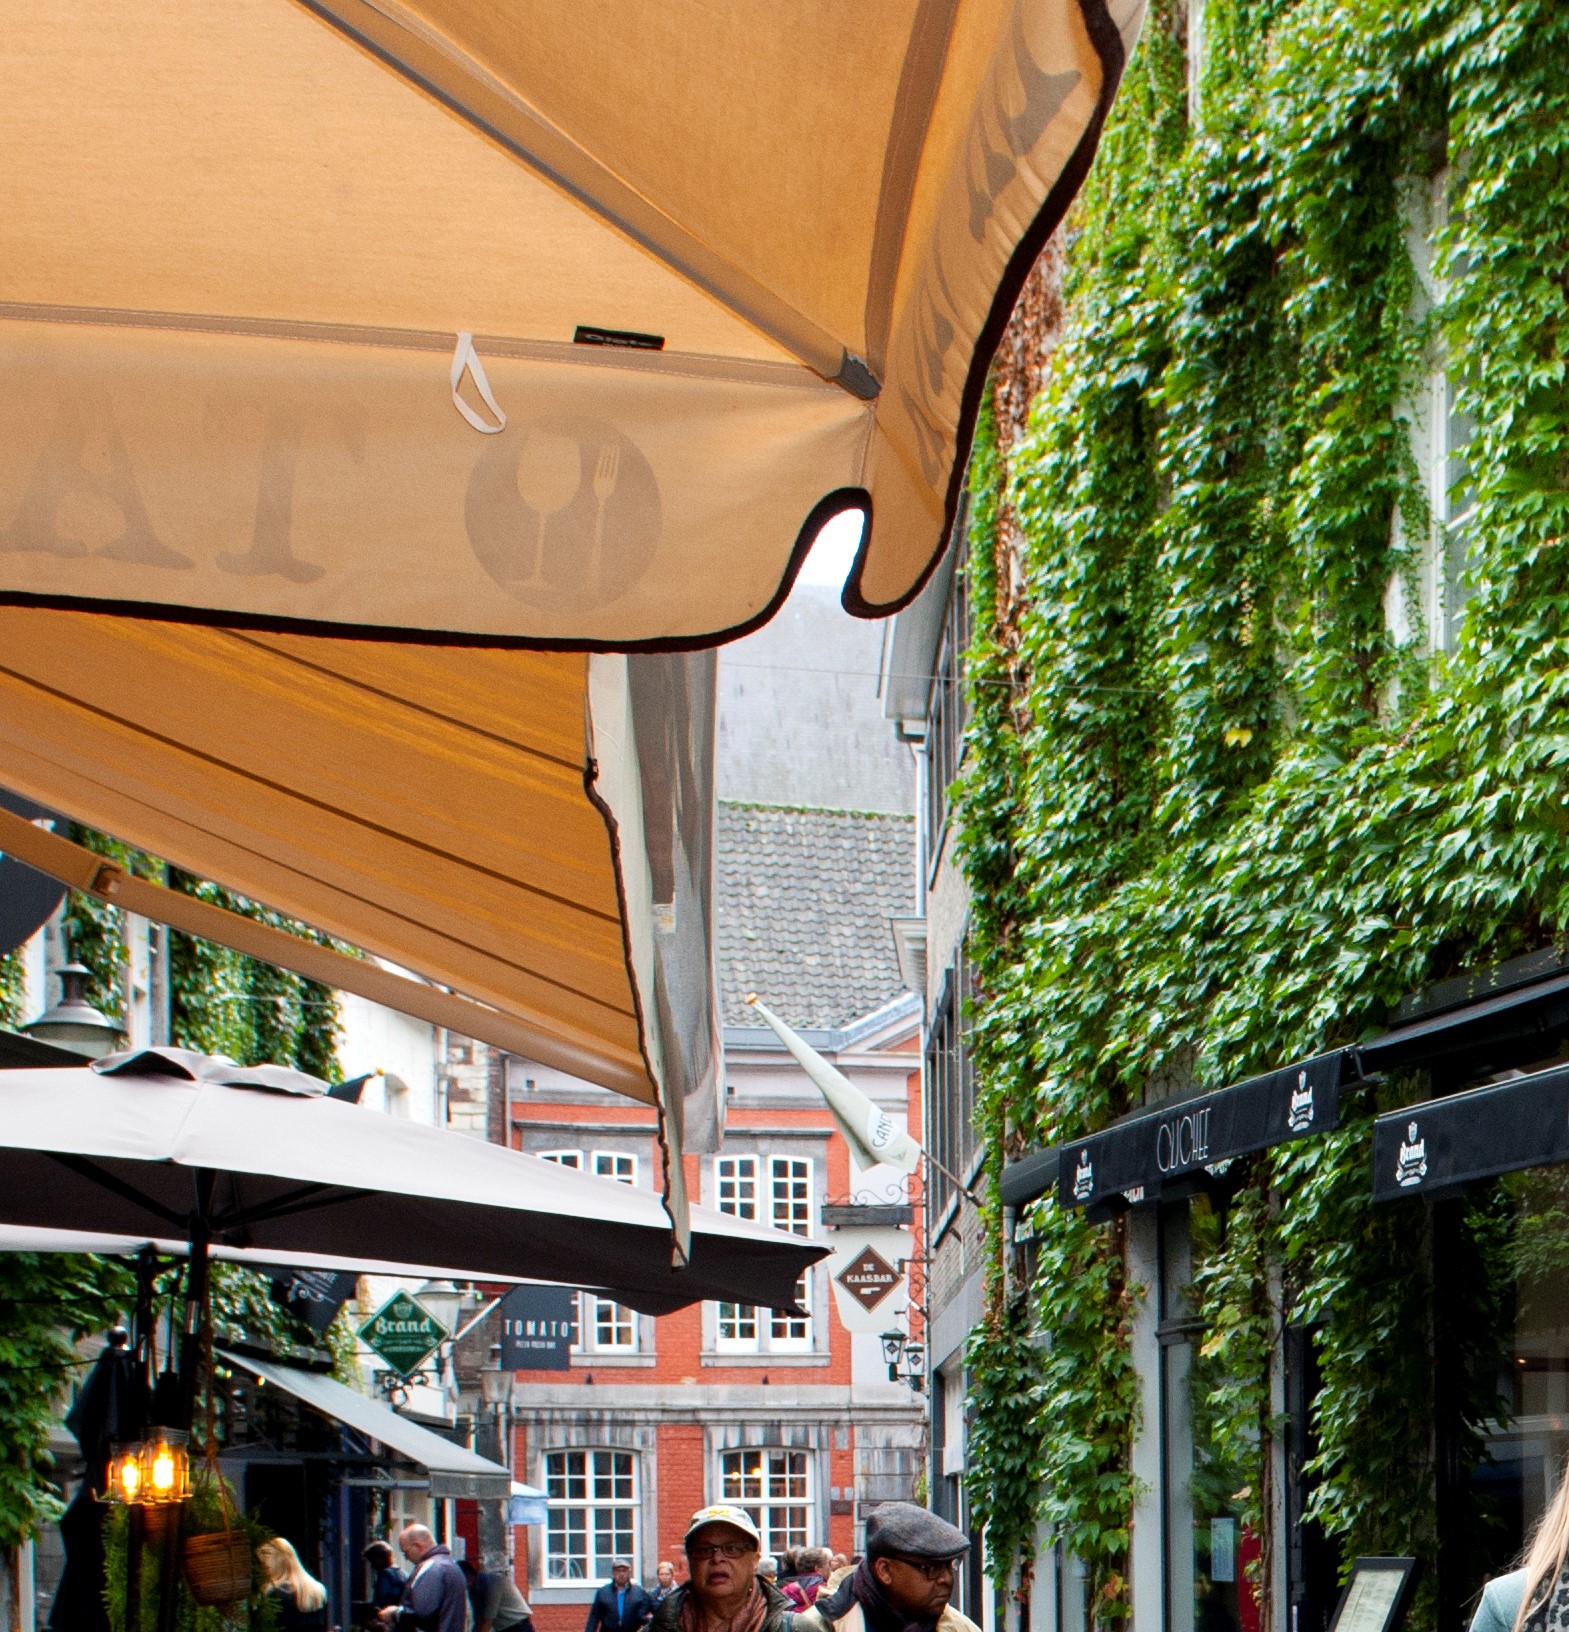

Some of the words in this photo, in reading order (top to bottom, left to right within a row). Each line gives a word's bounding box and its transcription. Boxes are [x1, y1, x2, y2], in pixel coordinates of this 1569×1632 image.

[1157, 1107, 1212, 1172] CLICHEE
[847, 1274, 893, 1283] KAASBAR
[375, 1316, 431, 1335] Brand
[505, 1319, 569, 1338] TOMATO
